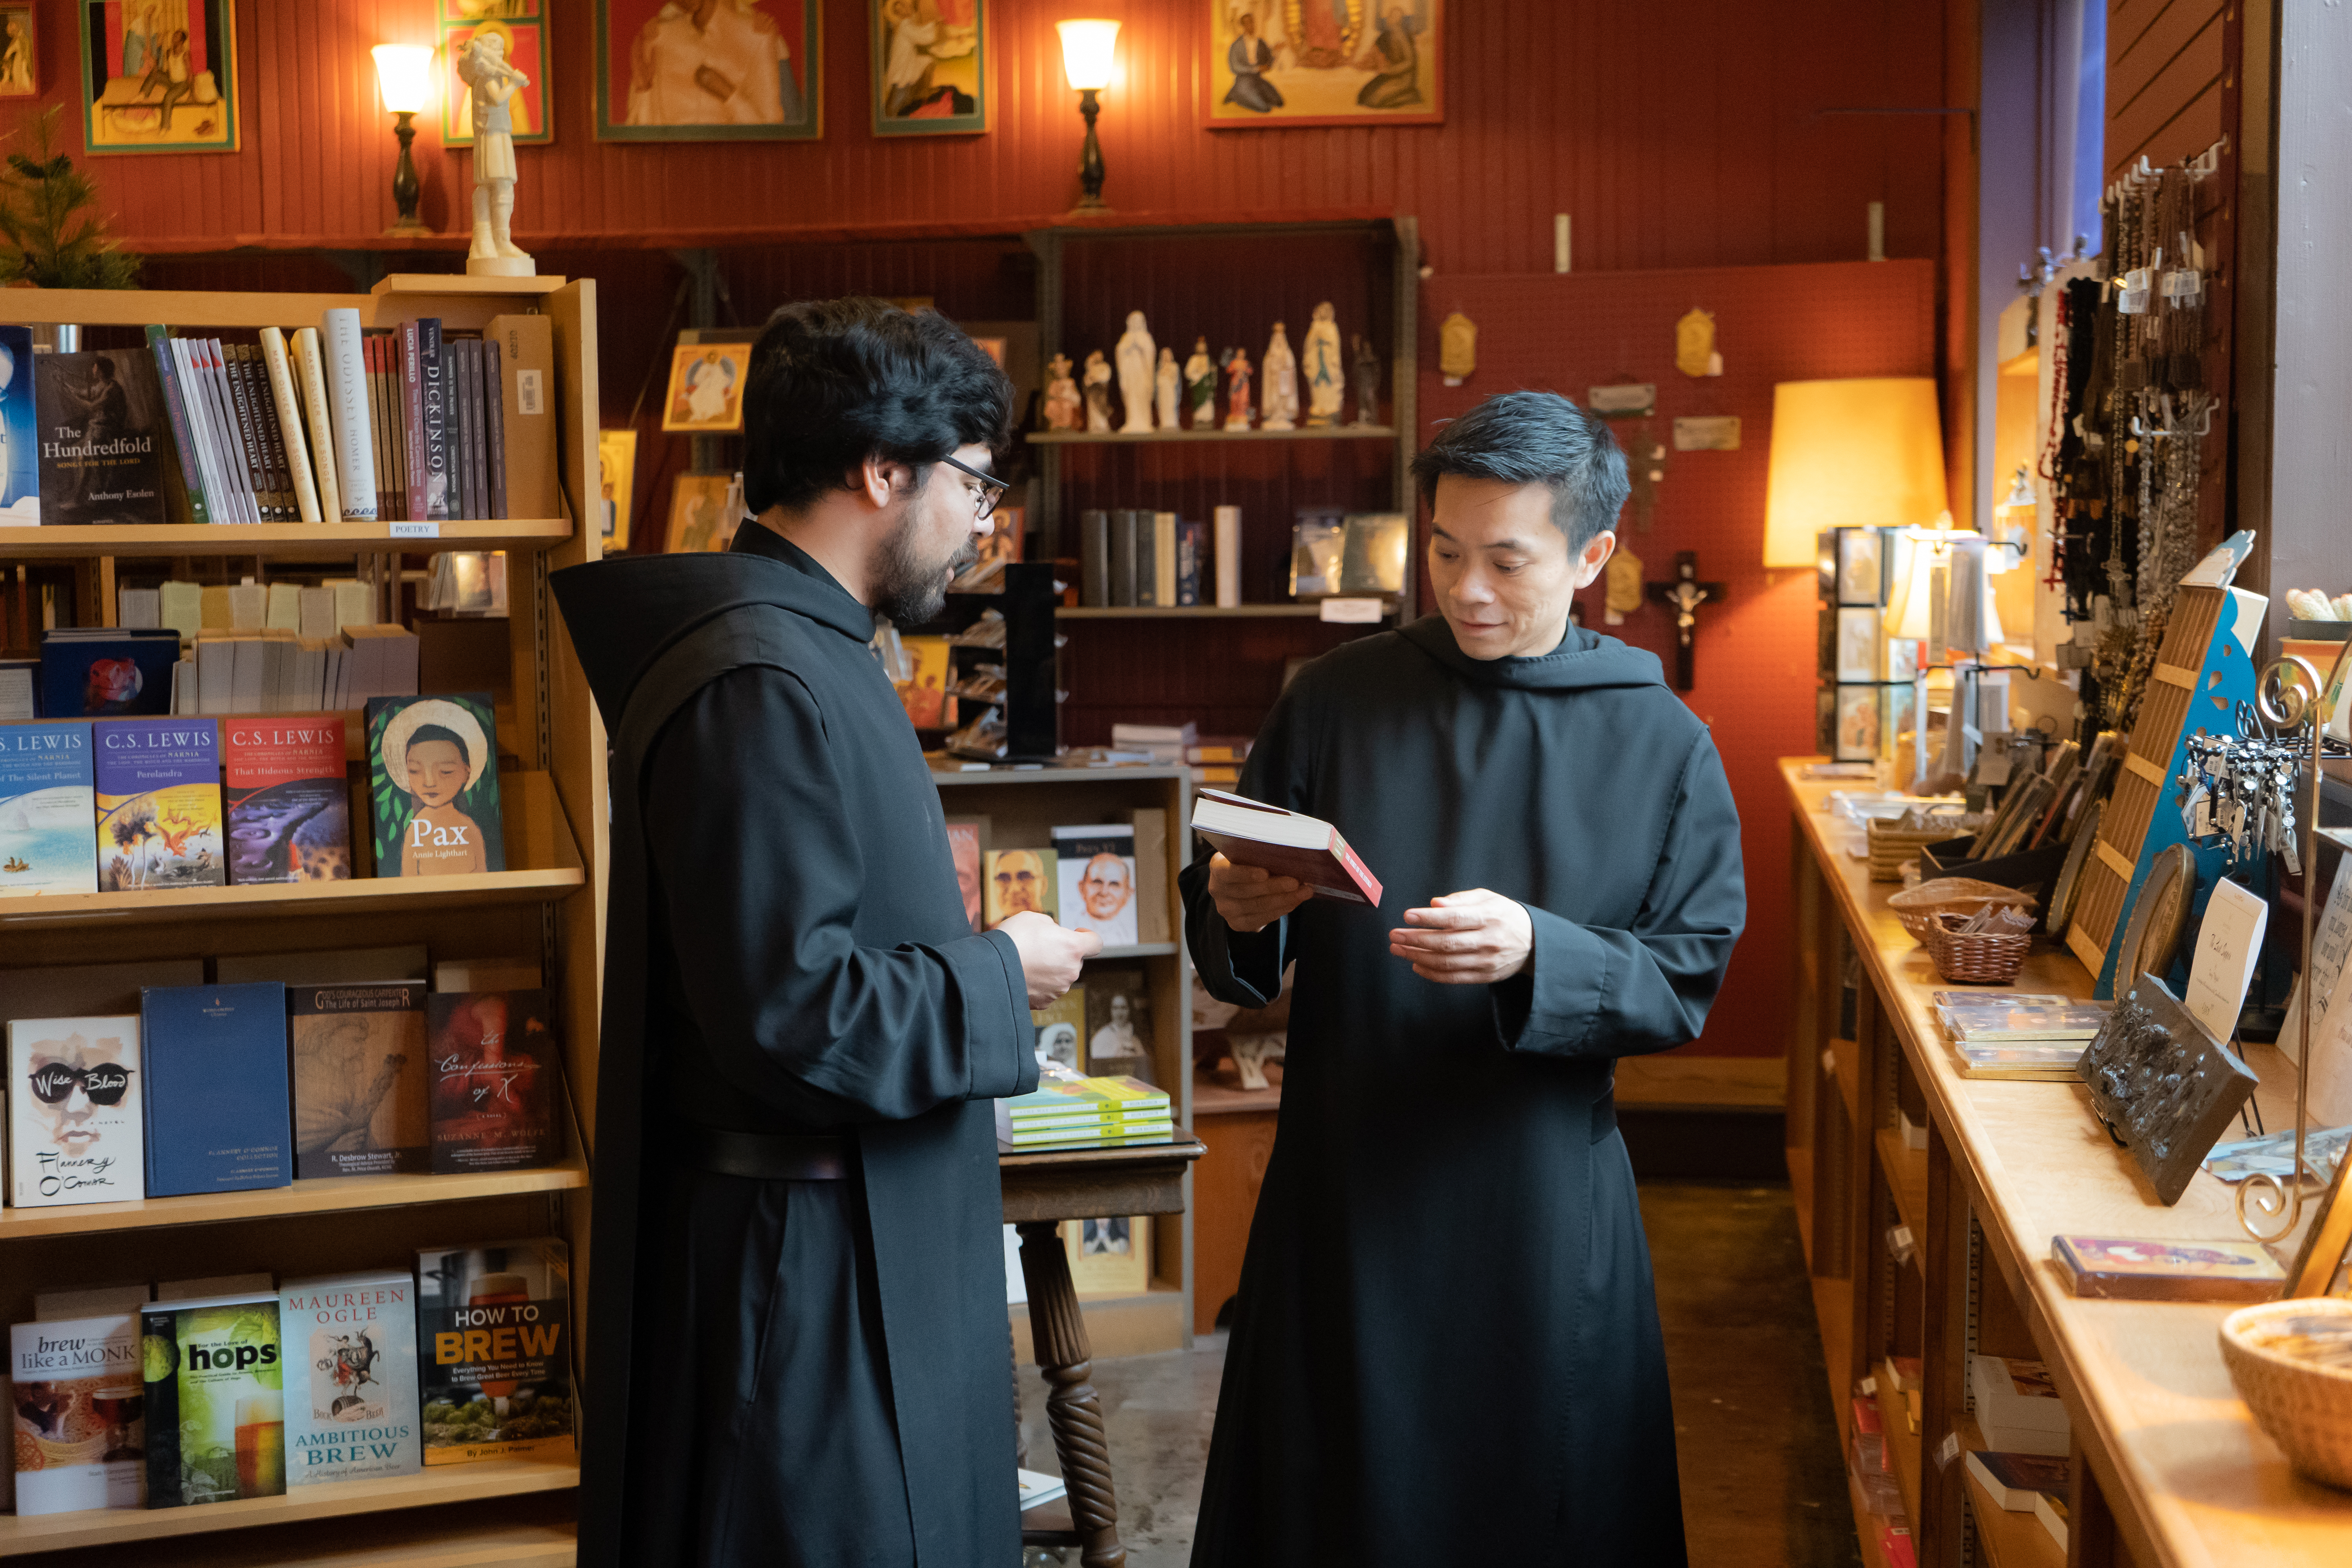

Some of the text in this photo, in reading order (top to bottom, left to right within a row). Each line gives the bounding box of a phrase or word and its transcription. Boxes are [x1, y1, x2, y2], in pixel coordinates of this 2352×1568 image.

[339, 318, 350, 345] THE
[407, 328, 416, 383] LUCIA PERILLO
[342, 354, 358, 424] ODYSSEY
[229, 362, 258, 469] THE ENLIGHTENED HEART
[243, 363, 272, 470] THE ENLIGHTENED HEART
[257, 363, 286, 470] THE ENLIGHTENED HEART
[272, 350, 305, 482] MARY OLIVER DOG SONGS
[307, 351, 330, 484] MARY OLIVER DOG SONGS
[427, 366, 443, 483] DICKINSON
[55, 426, 81, 438] The
[43, 437, 151, 458] Hundredfold
[349, 429, 361, 472] HOMER
[88, 489, 154, 502] Anthony Esolen
[395, 525, 430, 534] POETRY
[18, 734, 81, 751] LEWIS
[105, 731, 211, 749] C.S. LEWIS
[232, 730, 334, 746] C.S. LEWIS
[137, 769, 182, 778] Perelandra
[258, 767, 293, 775] Hideous
[297, 766, 334, 775] Strength
[410, 818, 469, 847] Pax
[412, 849, 468, 860] Annie Lighthart
[325, 998, 400, 1009] The Life of Saint Joseph
[336, 990, 374, 999] COURAGEOUS
[436, 1053, 541, 1077] Confessions
[36, 1072, 127, 1097] Wise Blood
[473, 1074, 518, 1103] of X
[437, 1132, 485, 1141] SUZANNE
[511, 1128, 545, 1137] WOLFE
[36, 1151, 116, 1174] Flannery
[289, 1289, 405, 1311] MAUREEN
[317, 1307, 377, 1324] OGLE
[455, 1305, 539, 1328] HOW TO
[38, 1336, 85, 1353] brew
[435, 1323, 560, 1365] BREW
[22, 1352, 54, 1368] like
[59, 1356, 67, 1366] a
[72, 1345, 135, 1365] MONK
[189, 1344, 277, 1371] hops
[453, 1364, 486, 1374] Everything
[487, 1363, 499, 1372] You
[500, 1362, 517, 1370] Need
[459, 1373, 476, 1381] Brew
[477, 1372, 494, 1381] Great
[512, 1370, 528, 1379] Every
[295, 1425, 410, 1447] AMBITIOUS
[306, 1442, 398, 1466] BREW
[467, 1449, 477, 1457] By
[508, 1445, 535, 1453] Palmer
[314, 1469, 341, 1477] History
[341, 1467, 348, 1476] of
[350, 1466, 383, 1474] American
